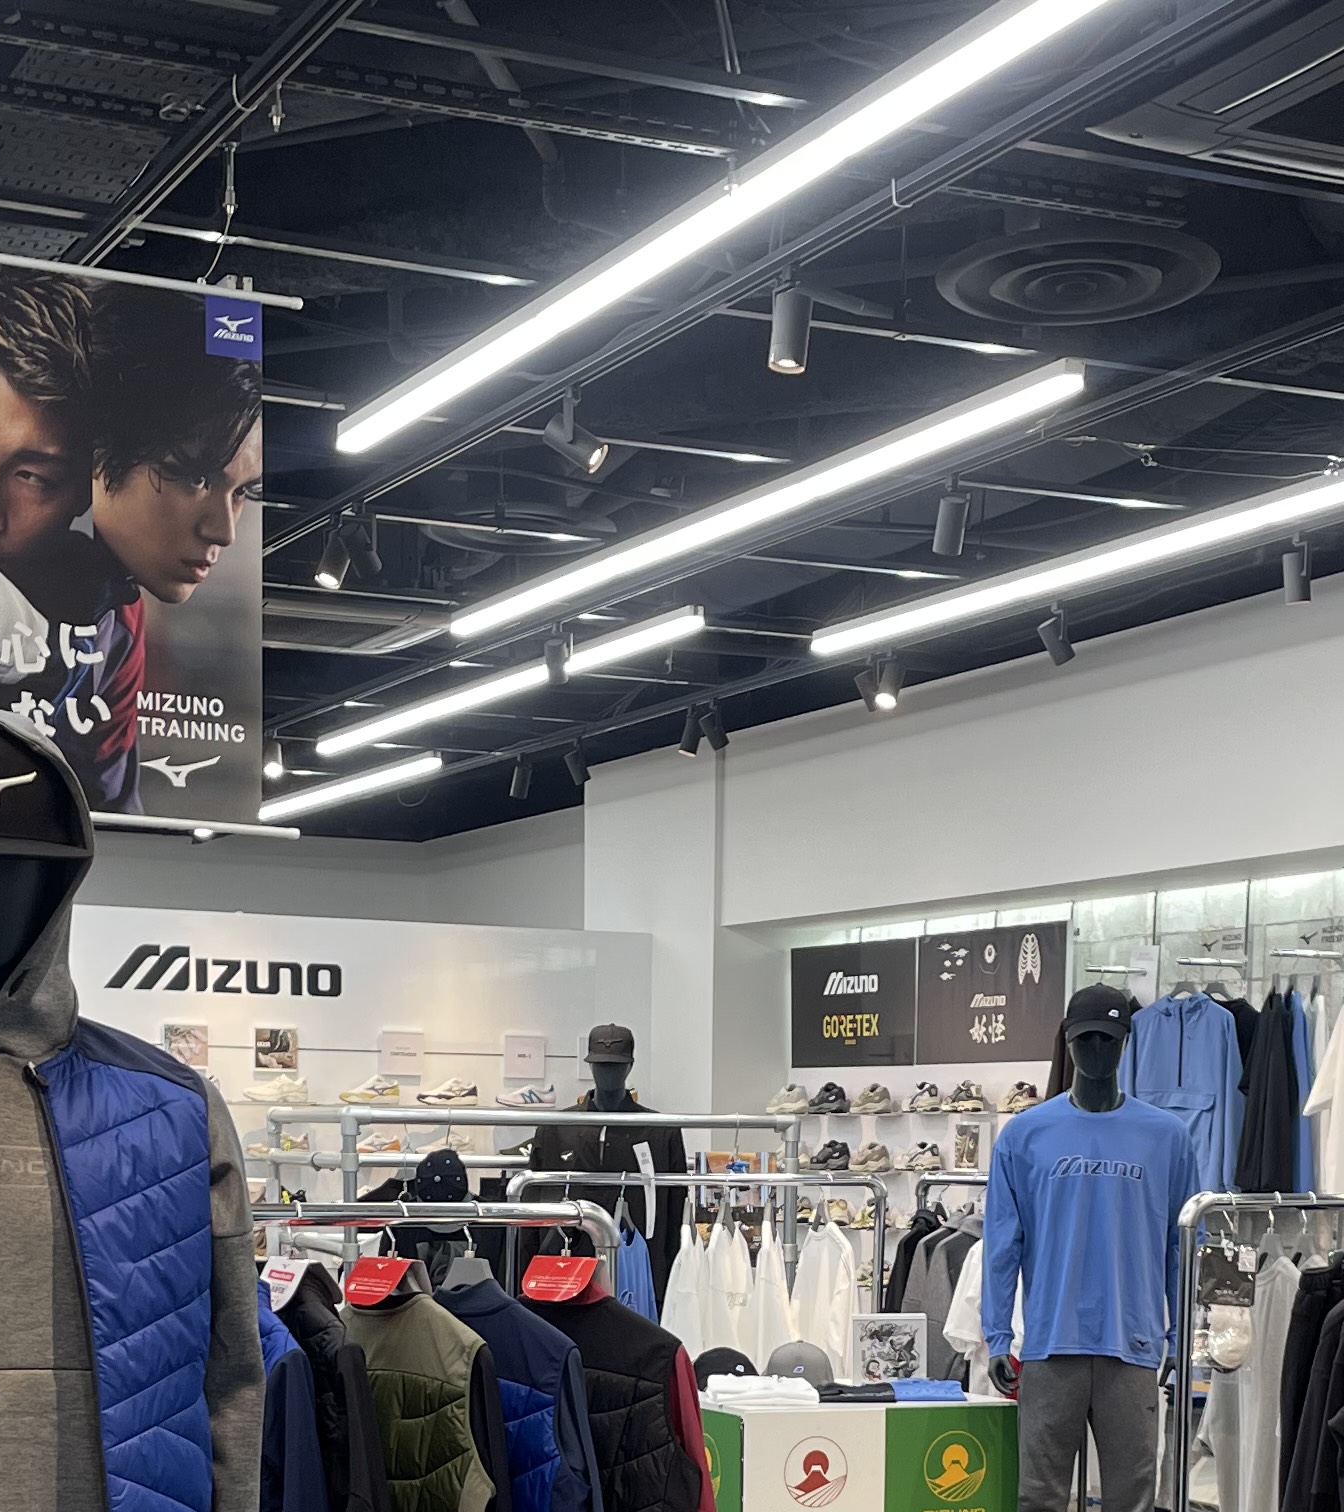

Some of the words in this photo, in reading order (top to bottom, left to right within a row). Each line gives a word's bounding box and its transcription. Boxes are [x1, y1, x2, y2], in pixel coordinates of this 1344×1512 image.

[137, 691, 224, 717] MIZUNO
[136, 715, 246, 743] TRAINING
[103, 944, 342, 998] MIZUNO
[822, 971, 879, 996] MIZUNO
[822, 1013, 880, 1038] GORE-TEX
[1048, 1154, 1144, 1181] MIZUNO
